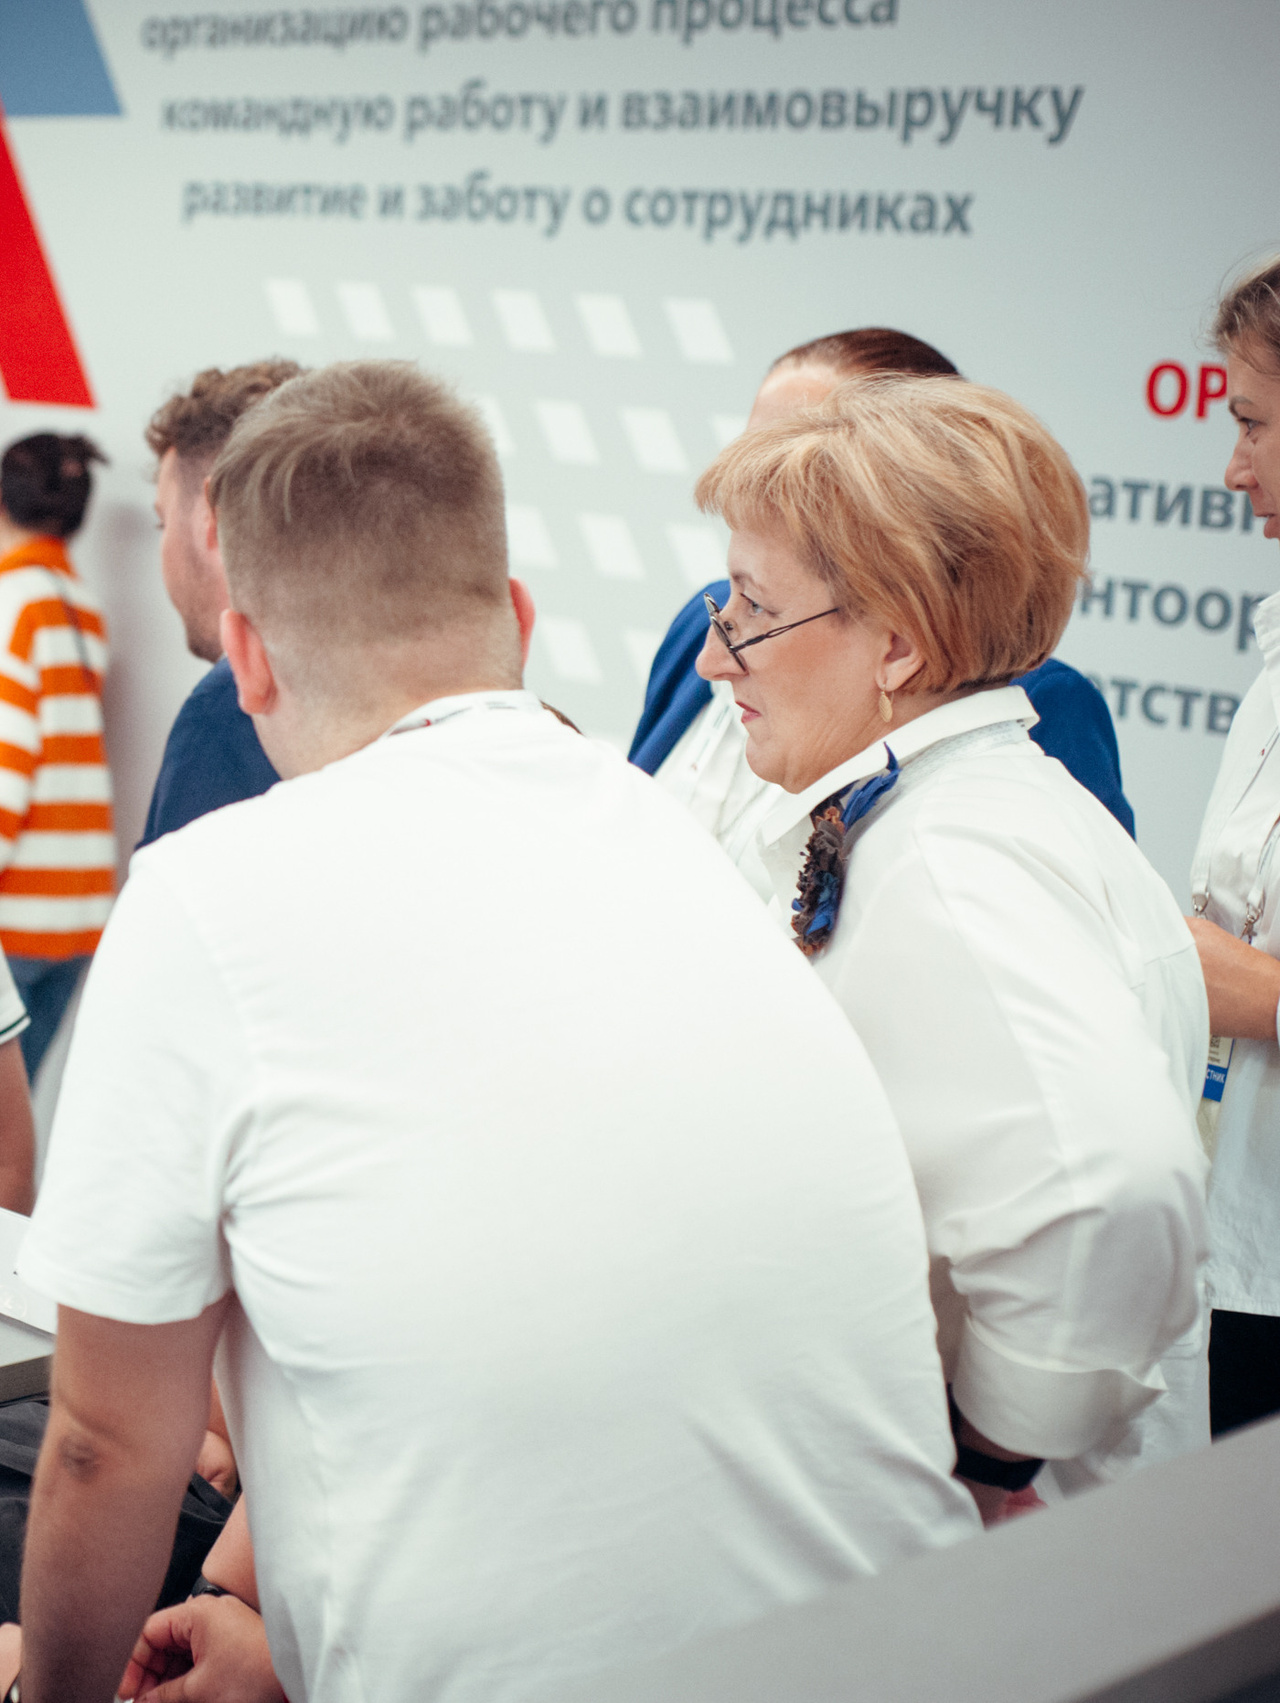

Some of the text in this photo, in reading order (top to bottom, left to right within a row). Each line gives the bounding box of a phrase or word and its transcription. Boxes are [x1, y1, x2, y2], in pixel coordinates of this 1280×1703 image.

[140, 0, 900, 60] организацию рабочего процесса
[160, 77, 1085, 148] командную работу и взаимовыручку
[181, 169, 974, 245] развитие и заботу о сотрудниках
[1146, 361, 1227, 419] ОР
[1092, 674, 1240, 734] тств
